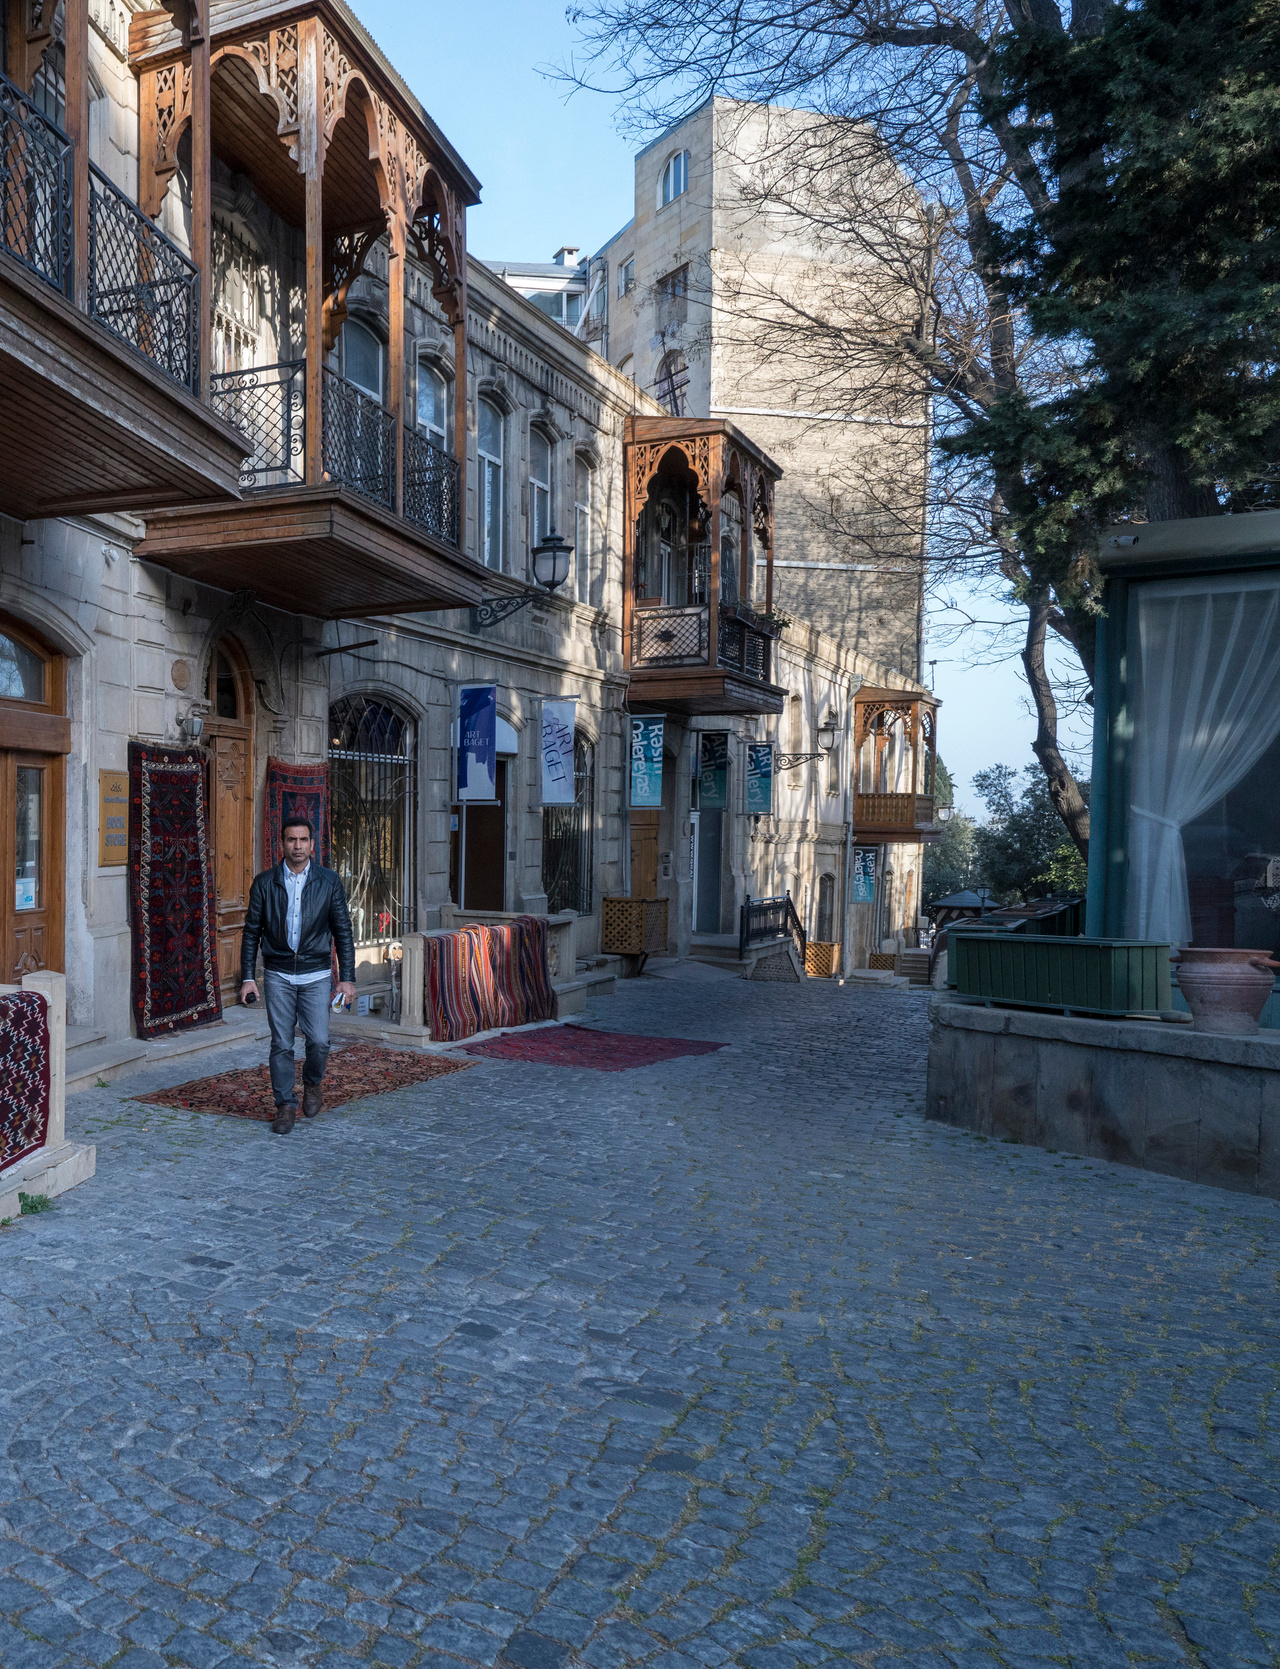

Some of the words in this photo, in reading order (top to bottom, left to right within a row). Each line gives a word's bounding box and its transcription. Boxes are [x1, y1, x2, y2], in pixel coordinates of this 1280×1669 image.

[464, 730, 480, 739] ART
[463, 738, 490, 747] BAGET
[107, 816, 125, 829] BOOK
[105, 833, 127, 847] STORE
